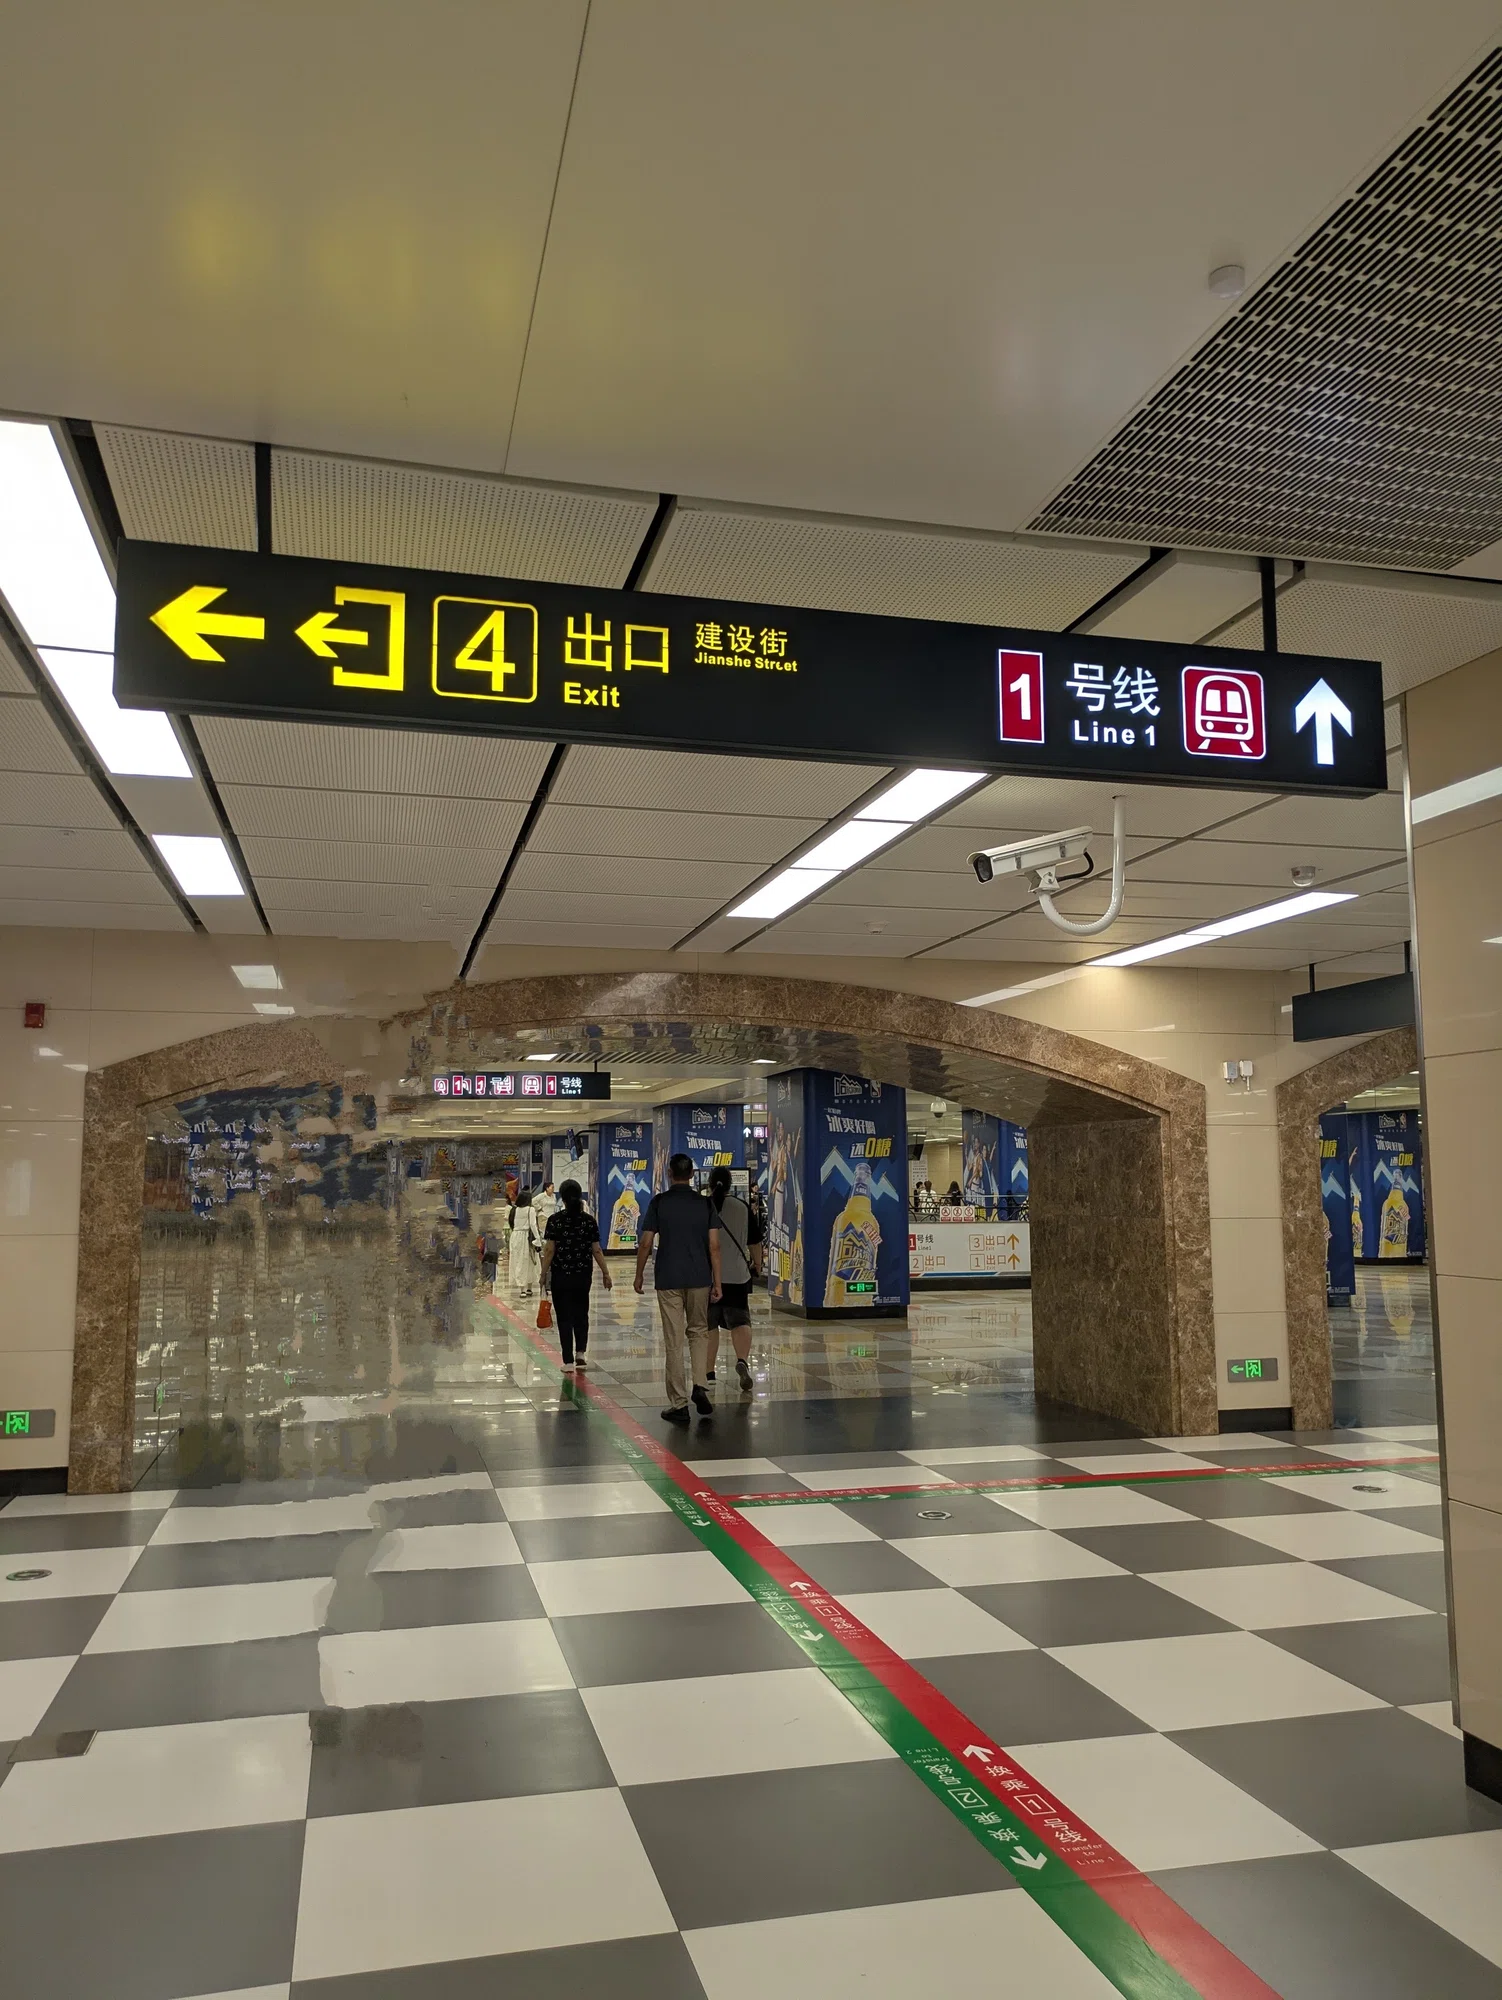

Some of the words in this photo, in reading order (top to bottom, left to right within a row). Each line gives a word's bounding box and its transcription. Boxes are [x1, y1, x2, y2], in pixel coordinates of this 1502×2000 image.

[694, 621, 789, 658] 建设街
[455, 609, 517, 693] 4
[563, 612, 670, 674] 出口
[694, 651, 752, 668] Jianshe
[563, 681, 621, 709] Exit
[1009, 672, 1033, 721] 1
[1065, 662, 1161, 717] 号线
[1073, 719, 1136, 746] Line
[1143, 725, 1157, 748] 1
[560, 1077, 583, 1089] 号线
[916, 1234, 934, 1244] 号线
[973, 1237, 981, 1249] 3
[985, 1235, 1006, 1246] 出口
[912, 1258, 919, 1269] 2
[925, 1255, 946, 1267] 出口
[986, 1254, 1007, 1266] 出口
[1059, 1843, 1104, 1854] Transfer
[1076, 1858, 1105, 1866] Line
